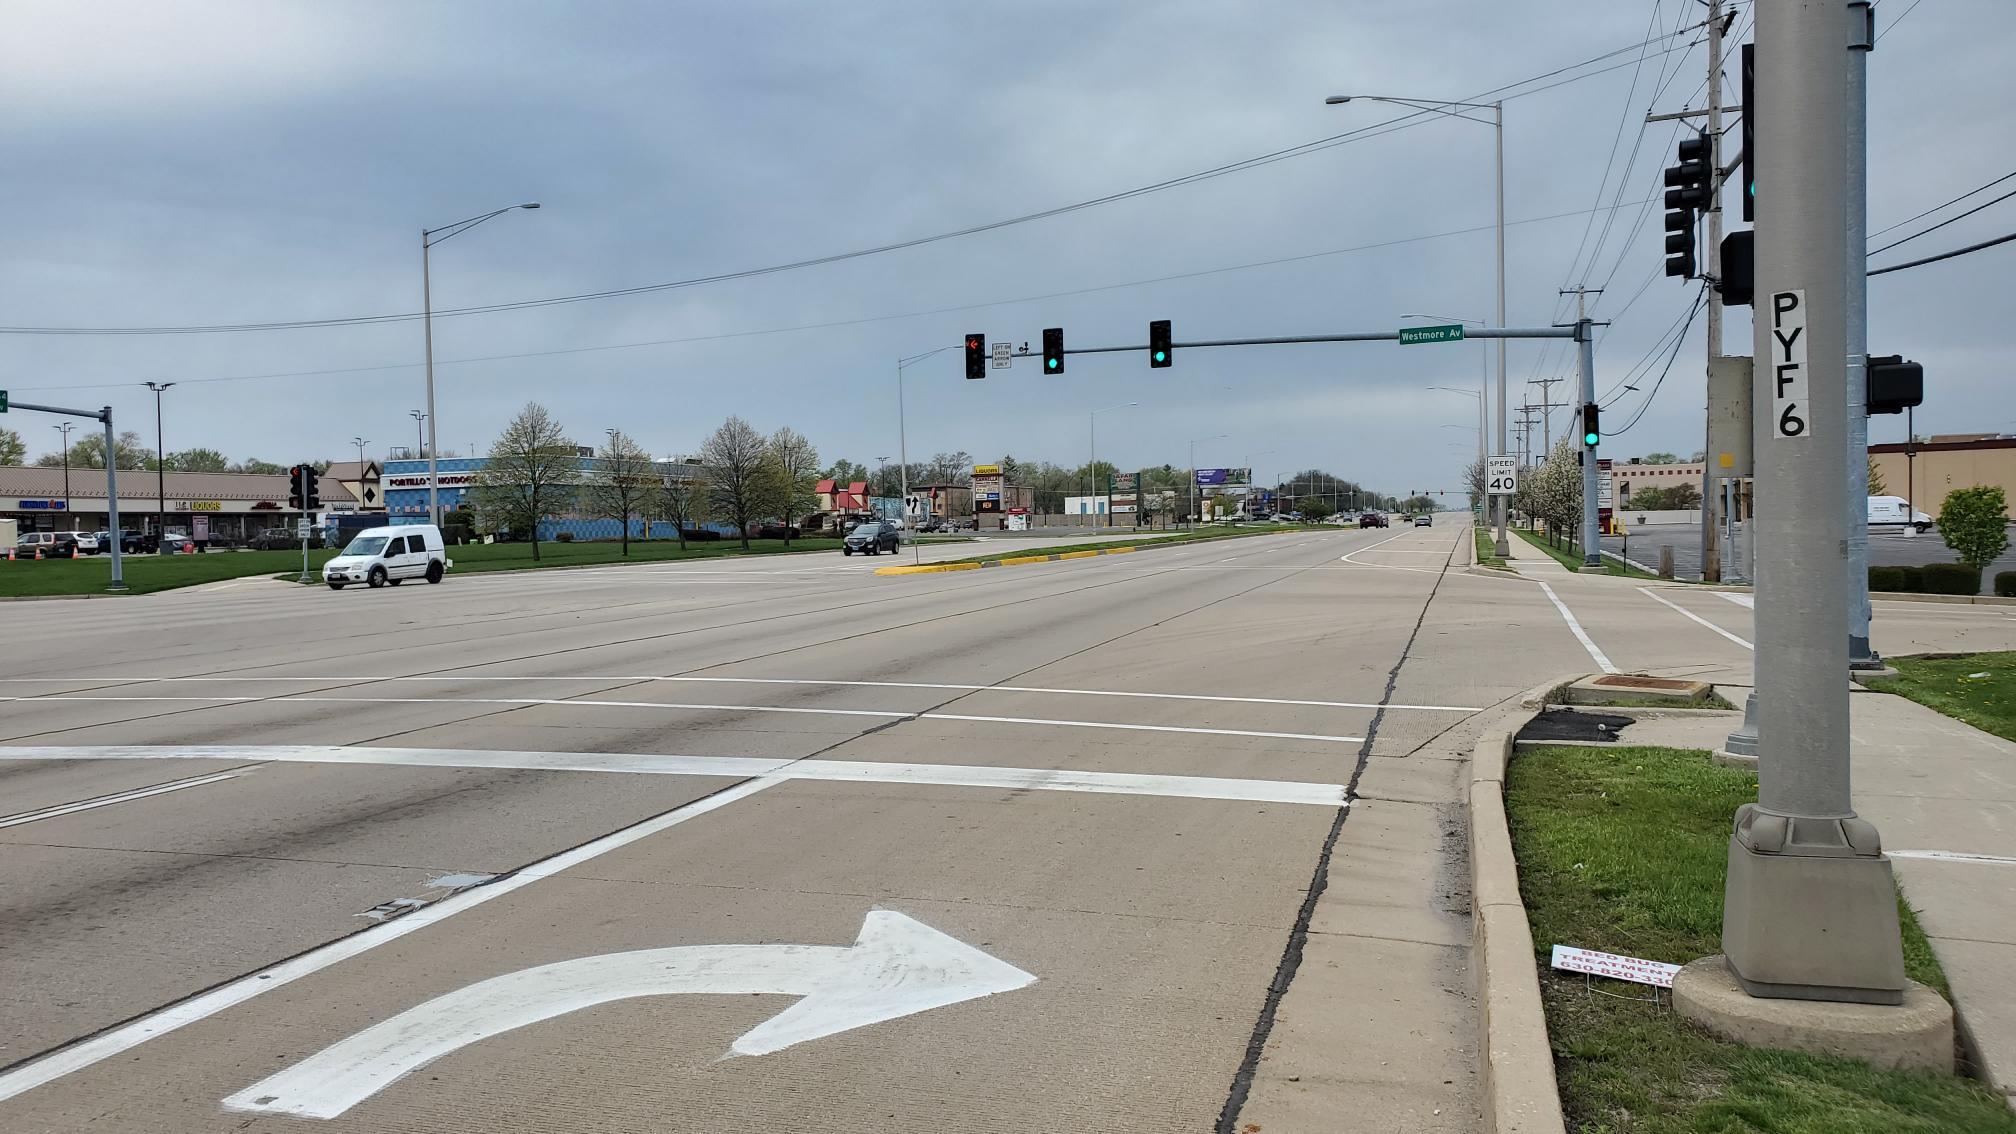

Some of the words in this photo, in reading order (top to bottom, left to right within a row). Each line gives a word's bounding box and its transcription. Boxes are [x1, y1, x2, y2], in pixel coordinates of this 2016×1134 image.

[1401, 331, 1445, 341] Westmore
[1449, 329, 1461, 338] Av
[389, 477, 432, 487] PORTILLO'
[1490, 477, 1514, 490] 40
[1581, 950, 1618, 961] BED
[1624, 958, 1665, 969] BUG
